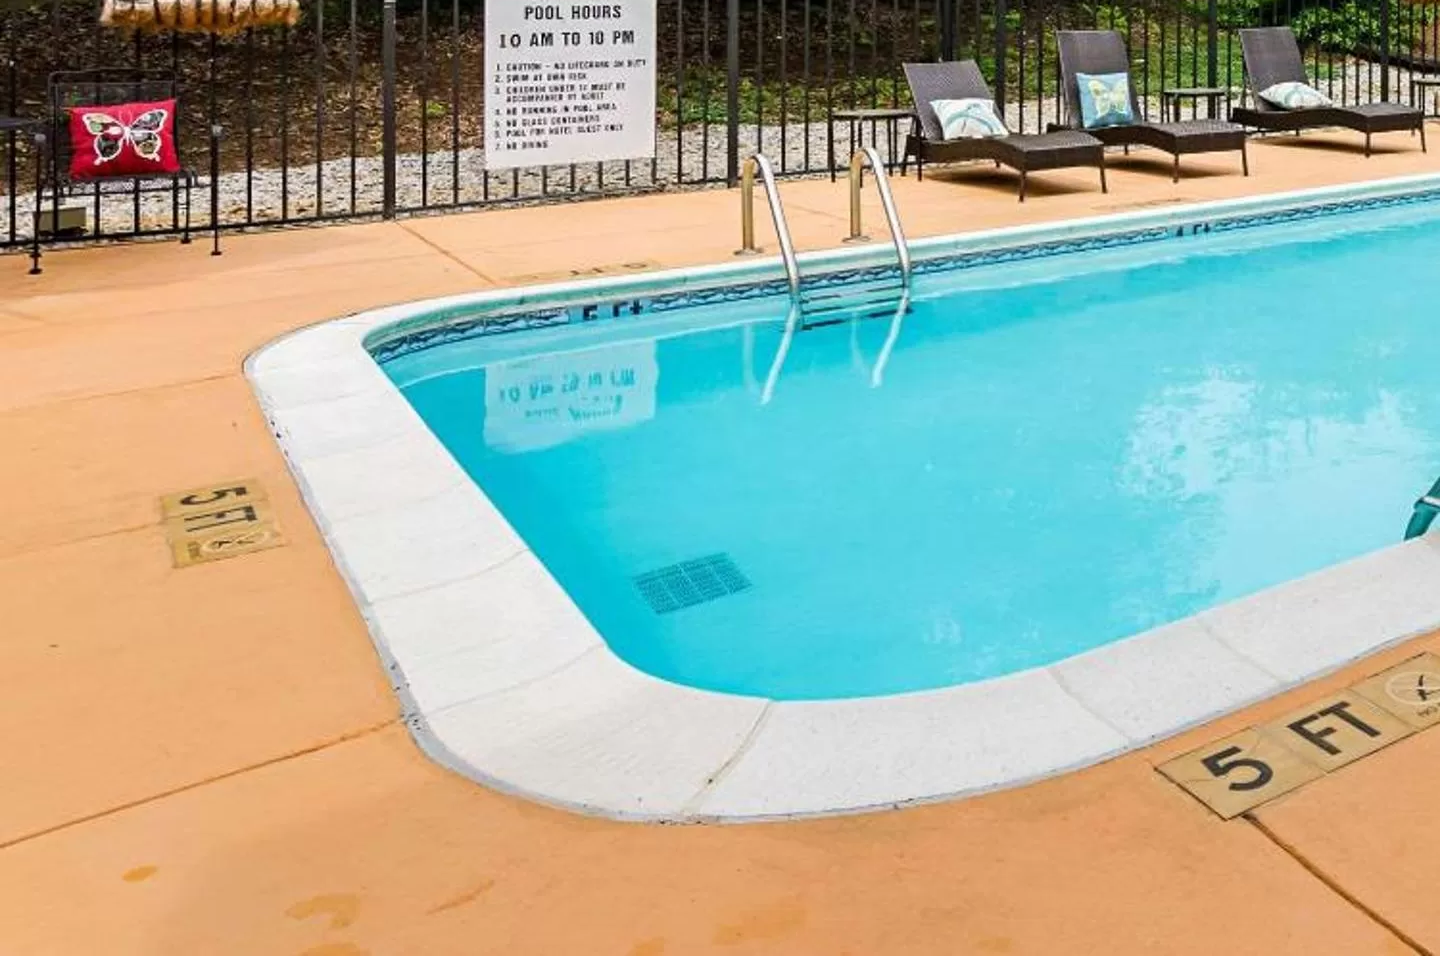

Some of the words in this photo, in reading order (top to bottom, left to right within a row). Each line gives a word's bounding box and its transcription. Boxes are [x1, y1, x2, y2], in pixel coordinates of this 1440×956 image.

[523, 5, 564, 20] POOL
[571, 5, 622, 20] HOURS
[529, 32, 554, 47] AM
[562, 31, 581, 46] TO
[589, 30, 604, 45] 10
[613, 29, 635, 44] PM
[180, 487, 247, 505] 5
[184, 505, 258, 533] FT
[1201, 745, 1273, 791] 5
[1287, 700, 1381, 755] FT
